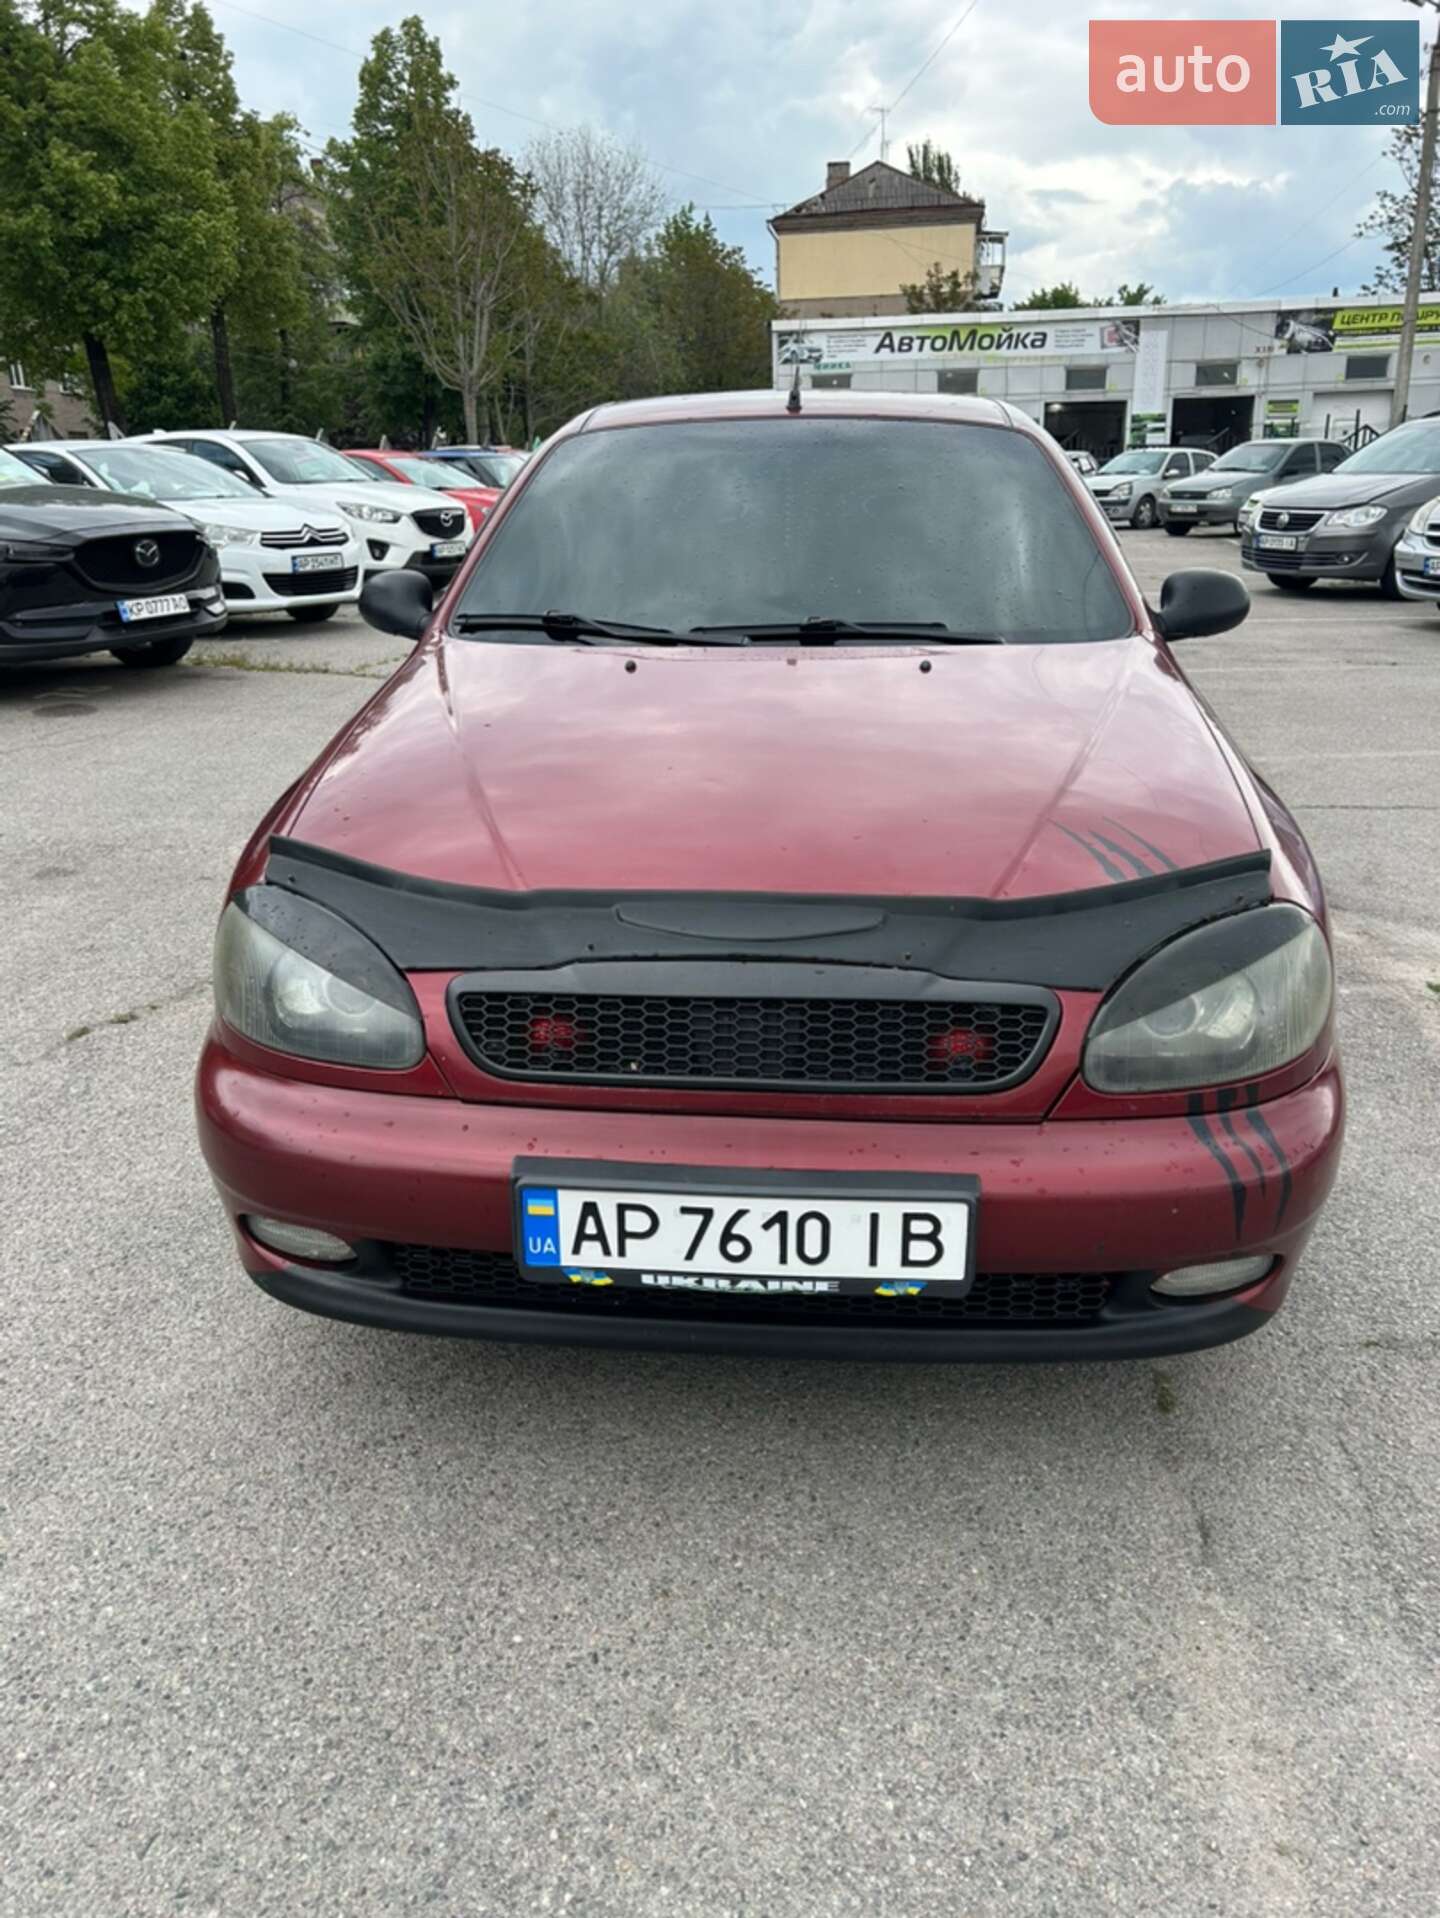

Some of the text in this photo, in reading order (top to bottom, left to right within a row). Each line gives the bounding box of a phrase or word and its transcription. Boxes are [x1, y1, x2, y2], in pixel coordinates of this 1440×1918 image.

[1340, 313, 1388, 326] ЦЕНТР
[874, 327, 1048, 353] АвтоМойка
[529, 1201, 944, 1268] UA AP 7610 IB
[640, 1274, 841, 1293] UKRAINE
